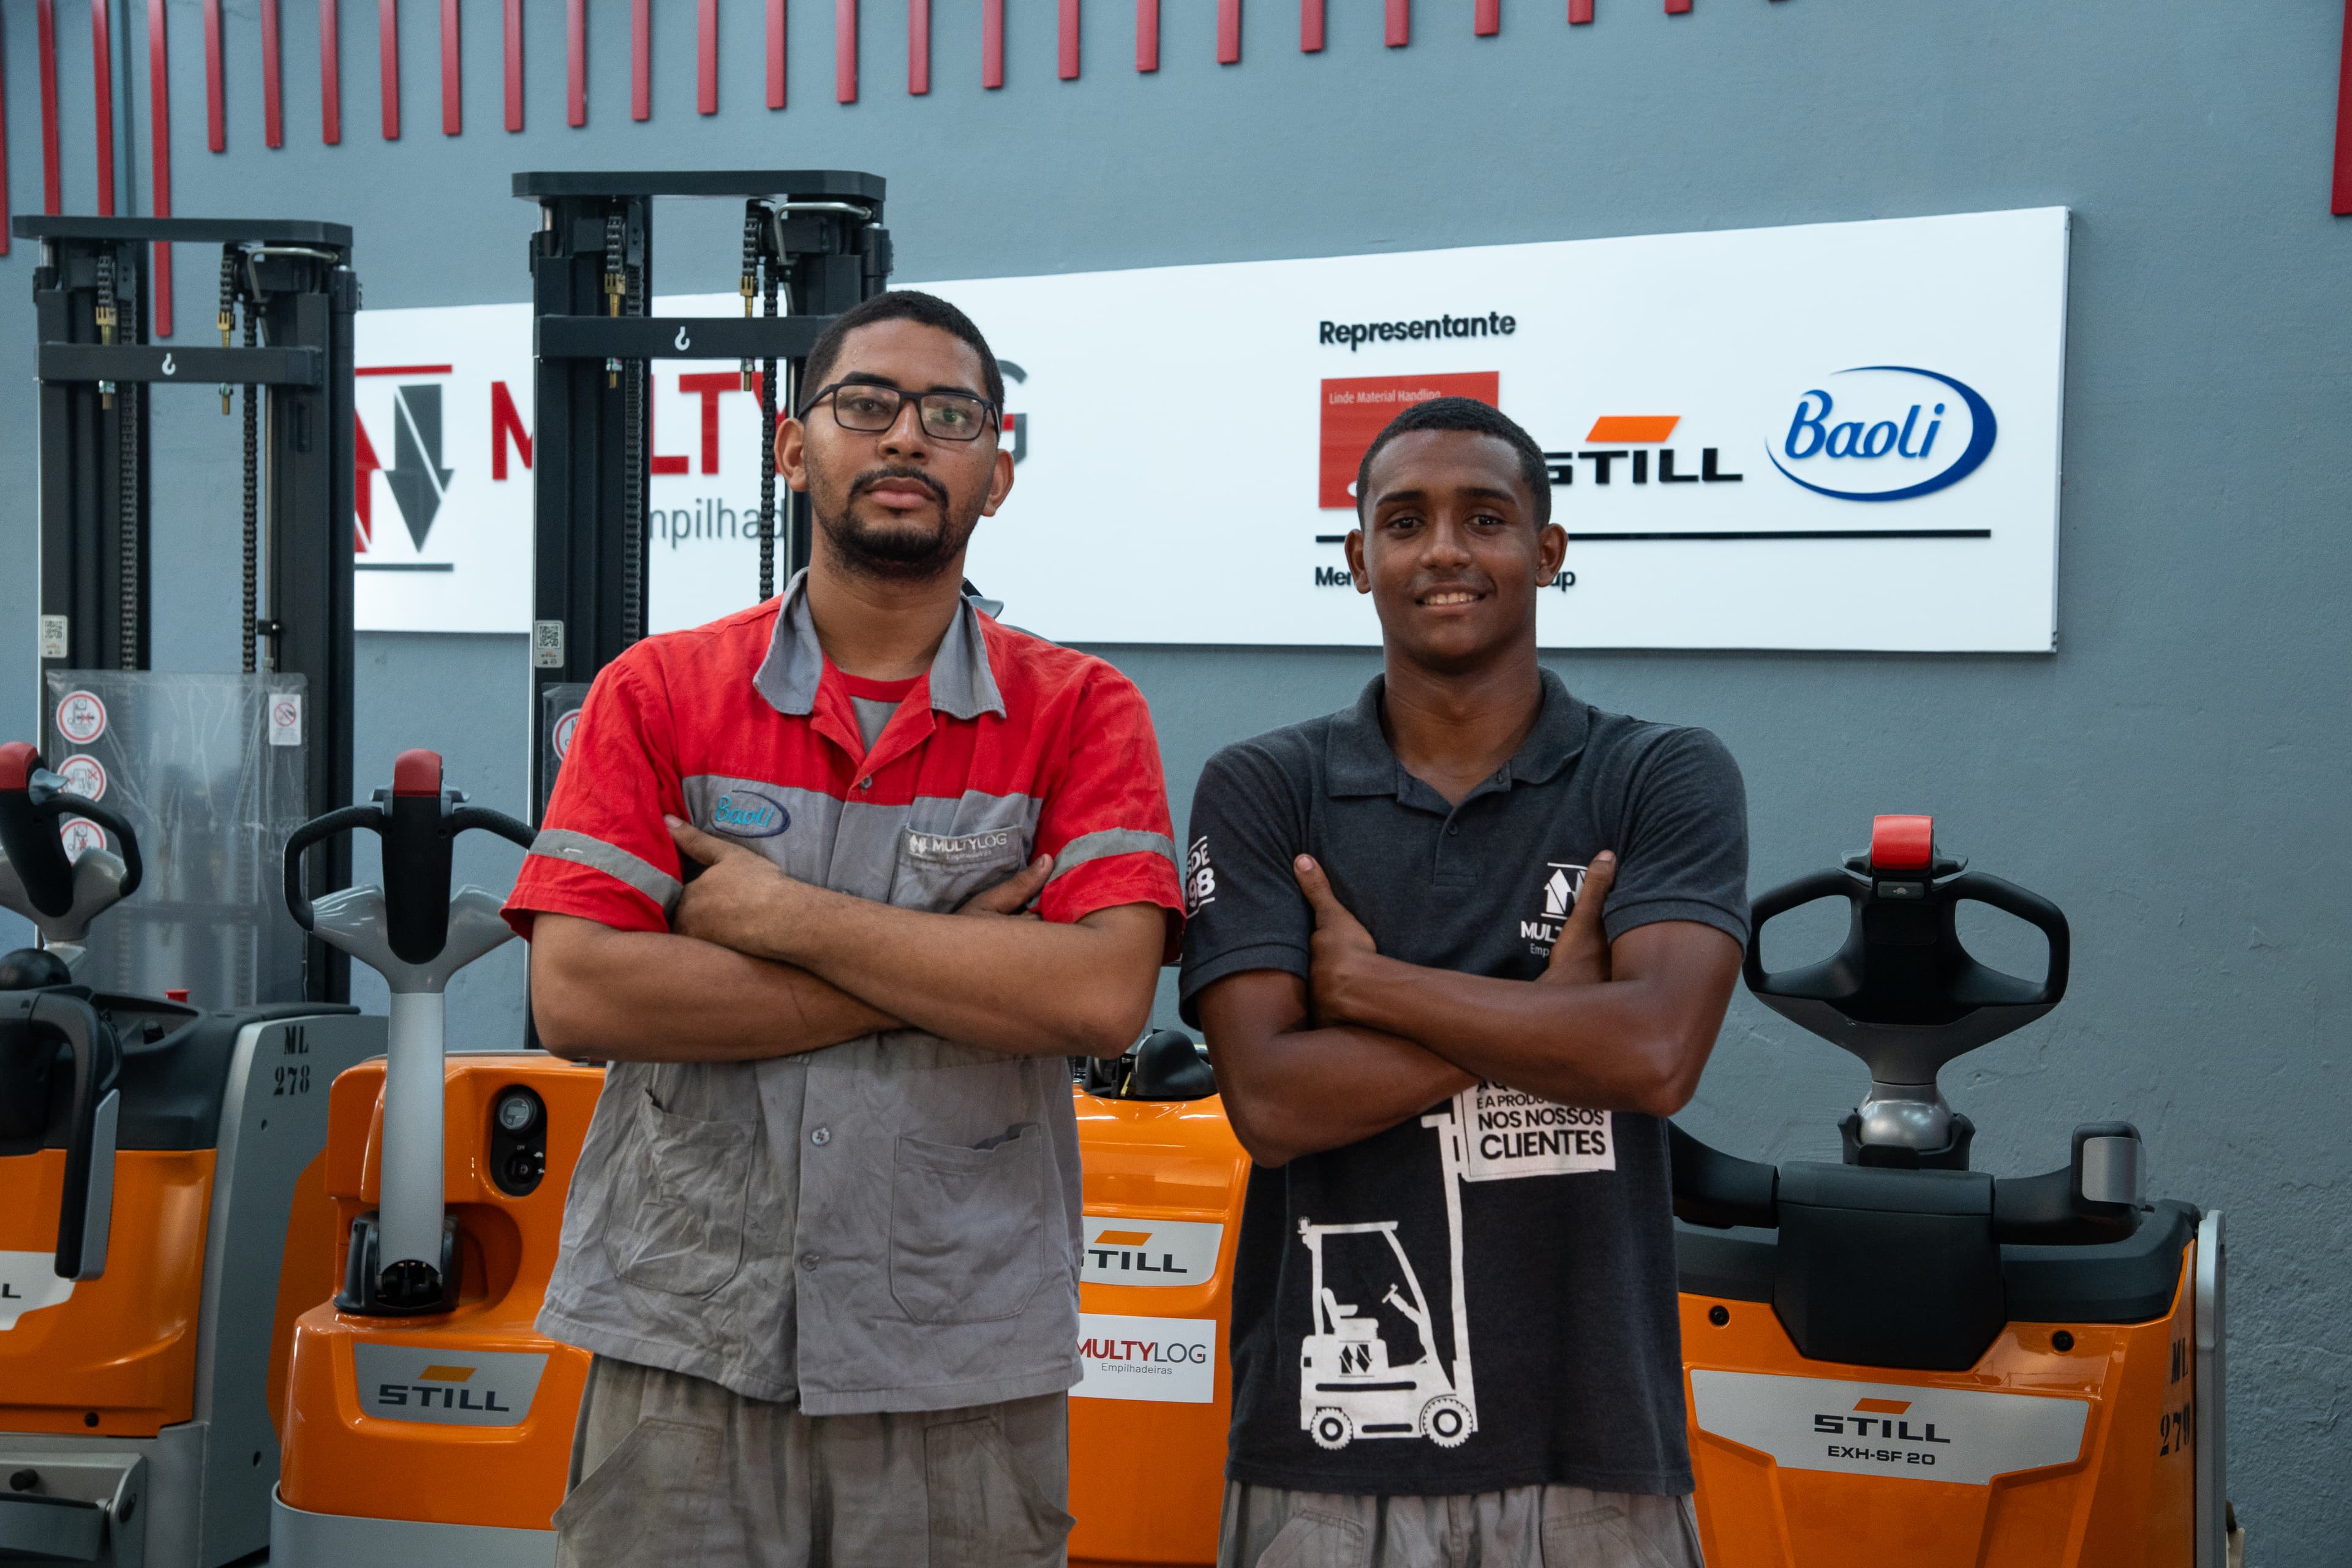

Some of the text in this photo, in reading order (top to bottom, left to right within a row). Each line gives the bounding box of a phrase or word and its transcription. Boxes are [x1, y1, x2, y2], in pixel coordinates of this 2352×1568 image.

[1319, 311, 1516, 352] Representante
[1329, 392, 1354, 404] Linde
[1357, 389, 1396, 403] Material
[1784, 389, 1946, 461] Baoli
[1544, 448, 1743, 484] STILL
[715, 795, 774, 828] Baoli
[932, 833, 1007, 852] MULTYLOG
[1188, 867, 1215, 907] 98
[284, 1025, 309, 1054] ML
[274, 1065, 310, 1095] 278
[1478, 1107, 1604, 1131] NOS NOSSOS
[1480, 1130, 1606, 1159] CLIENTES
[1082, 1249, 1187, 1273] TILL
[1101, 1362, 1172, 1375] Empilhadeiras
[379, 1383, 510, 1412] STILL
[1814, 1414, 1951, 1444] STILL
[1828, 1446, 1936, 1466] EXH-SF 20
